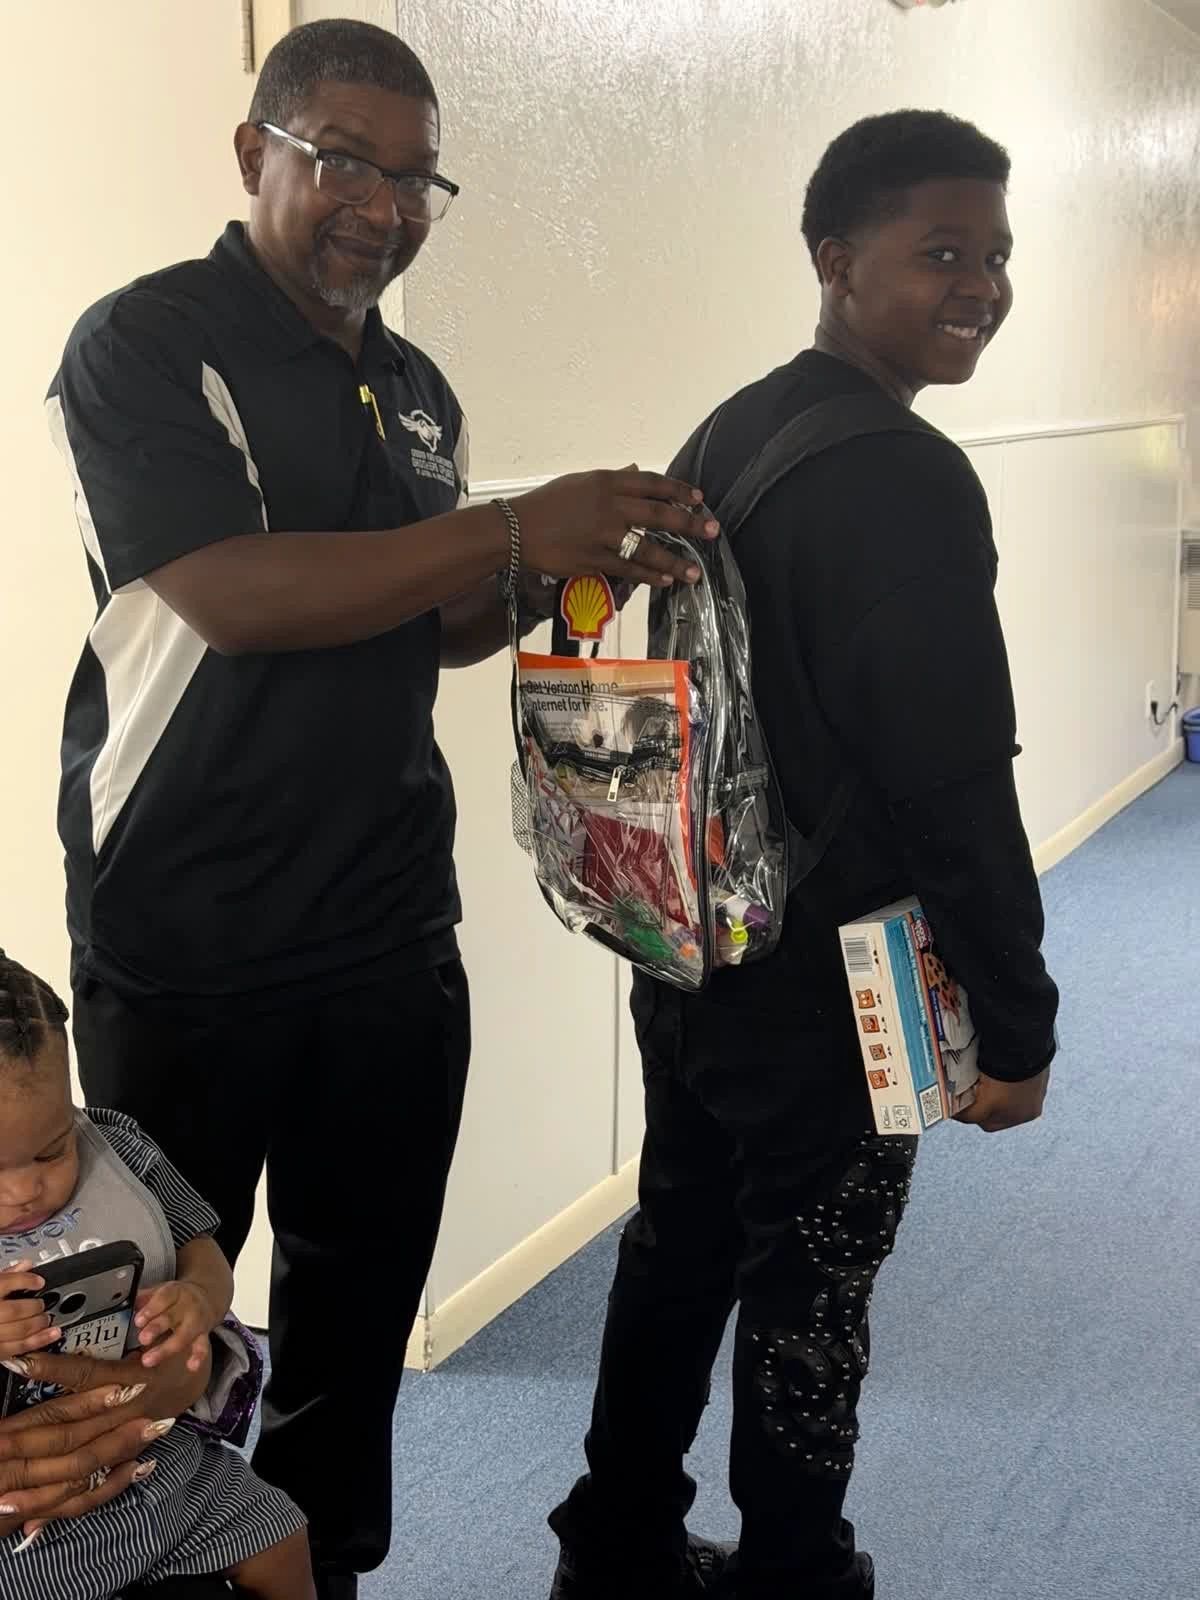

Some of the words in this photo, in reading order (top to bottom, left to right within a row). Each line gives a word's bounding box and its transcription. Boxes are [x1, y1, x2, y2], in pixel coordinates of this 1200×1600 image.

[543, 680, 580, 694] Verizon
[581, 680, 618, 695] Home
[568, 697, 581, 711] for
[583, 698, 608, 712] free.
[98, 1315, 115, 1325] THE
[74, 1326, 119, 1347] Blu
